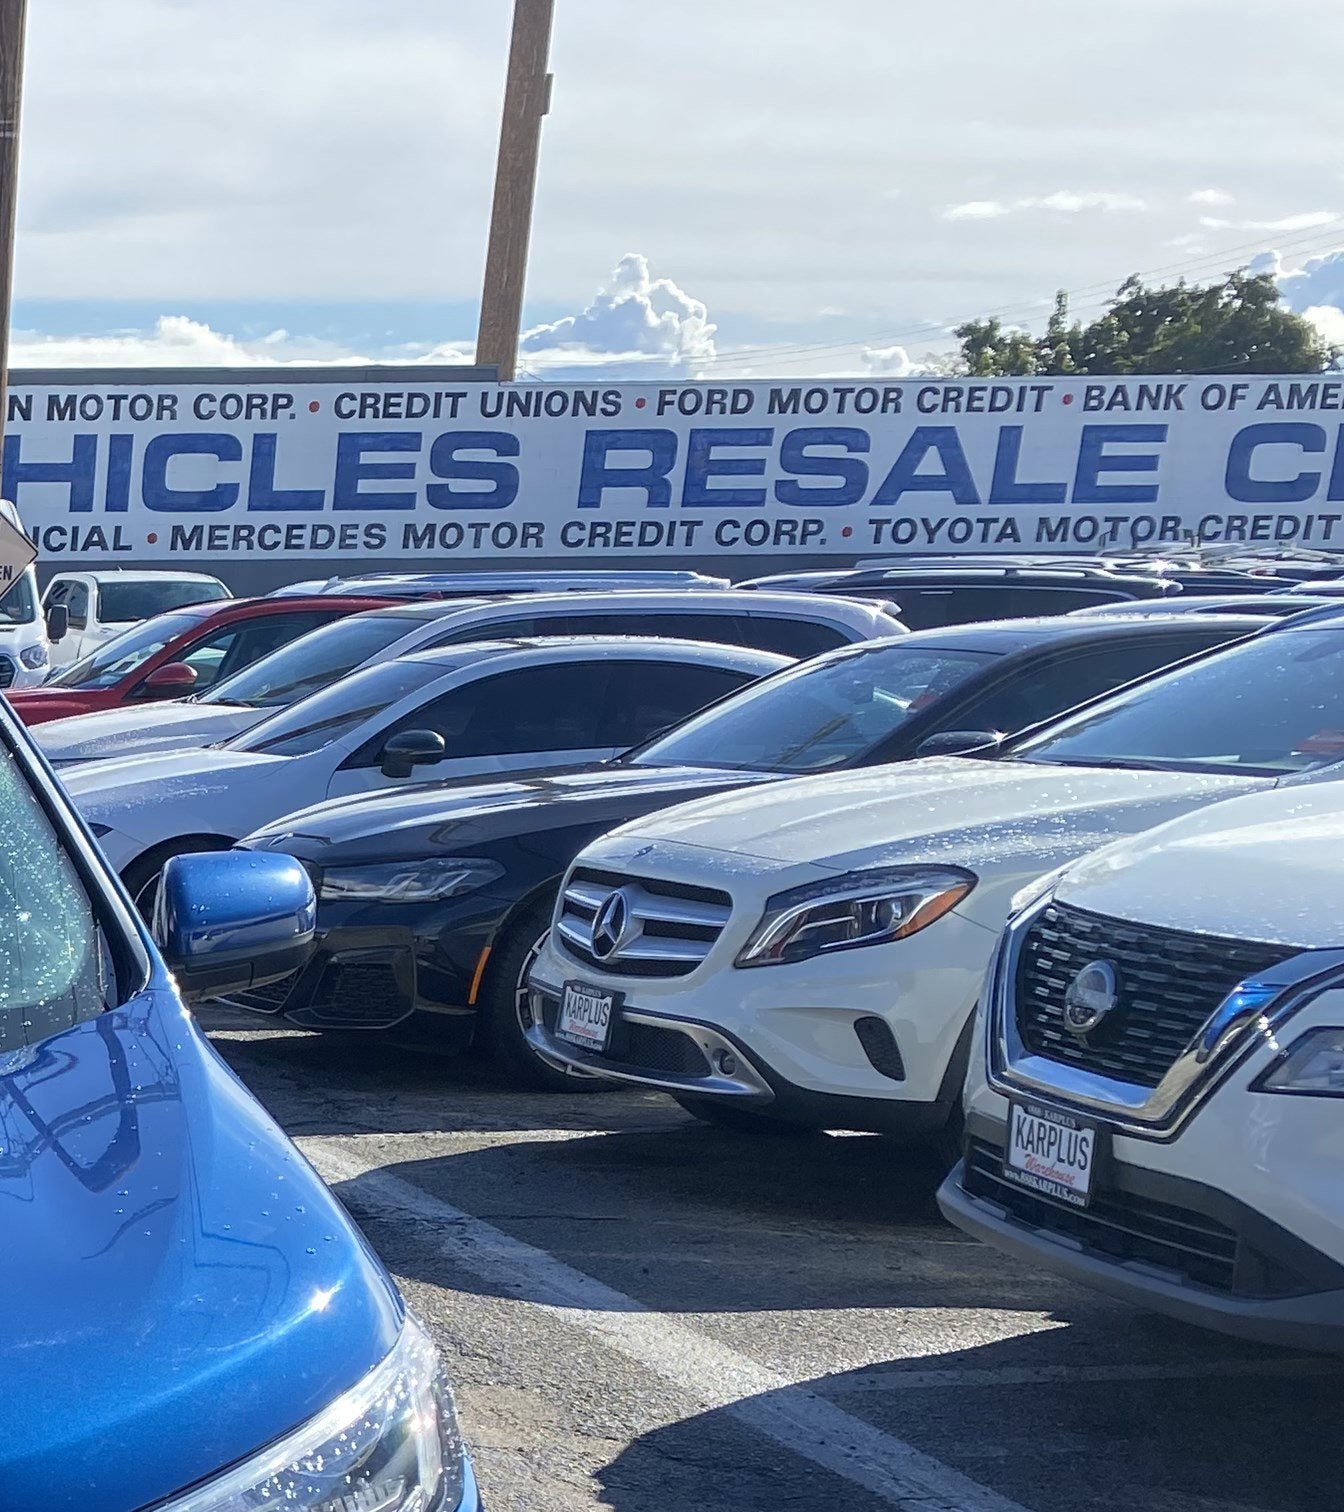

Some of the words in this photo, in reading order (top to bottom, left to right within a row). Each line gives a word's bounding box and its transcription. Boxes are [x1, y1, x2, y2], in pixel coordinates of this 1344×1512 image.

[47, 393, 184, 422] MOTOR
[194, 392, 296, 421] CORP.
[334, 391, 466, 420] CREDIT
[480, 388, 622, 419] UNIONS
[656, 388, 752, 417] FORD
[769, 386, 902, 416] MOTOR
[916, 384, 1052, 414] CREDIT
[1083, 384, 1188, 412] BANK
[1201, 384, 1249, 411] OF
[577, 422, 1169, 509] RESALE
[1224, 421, 1344, 504] C
[169, 523, 387, 552] MERCEDES
[401, 520, 545, 550] MOTOR
[560, 519, 703, 549] CREDIT
[714, 518, 827, 547] CORP.
[868, 516, 1016, 545] TOYOTA
[1036, 515, 1182, 545] MOTOR
[1198, 514, 1343, 542] CREDIT
[565, 992, 609, 1026] KARPLUS
[1016, 1114, 1090, 1170] KARPLUS
